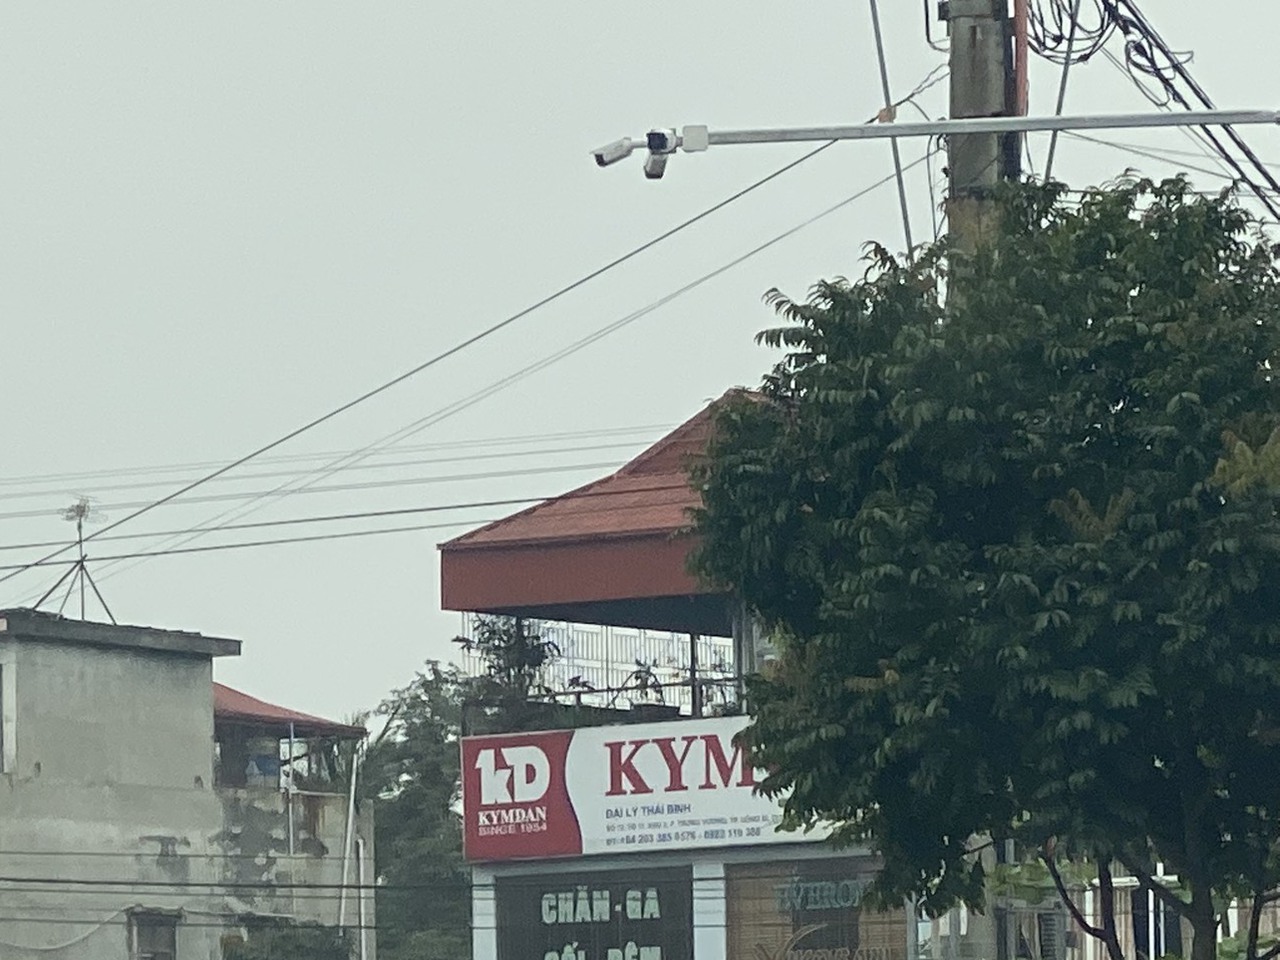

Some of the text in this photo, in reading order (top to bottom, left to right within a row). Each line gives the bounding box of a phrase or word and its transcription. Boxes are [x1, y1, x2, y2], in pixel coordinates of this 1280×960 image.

[604, 733, 768, 797] KYM
[478, 806, 547, 826] KYMDAN
[626, 888, 661, 919] GA
